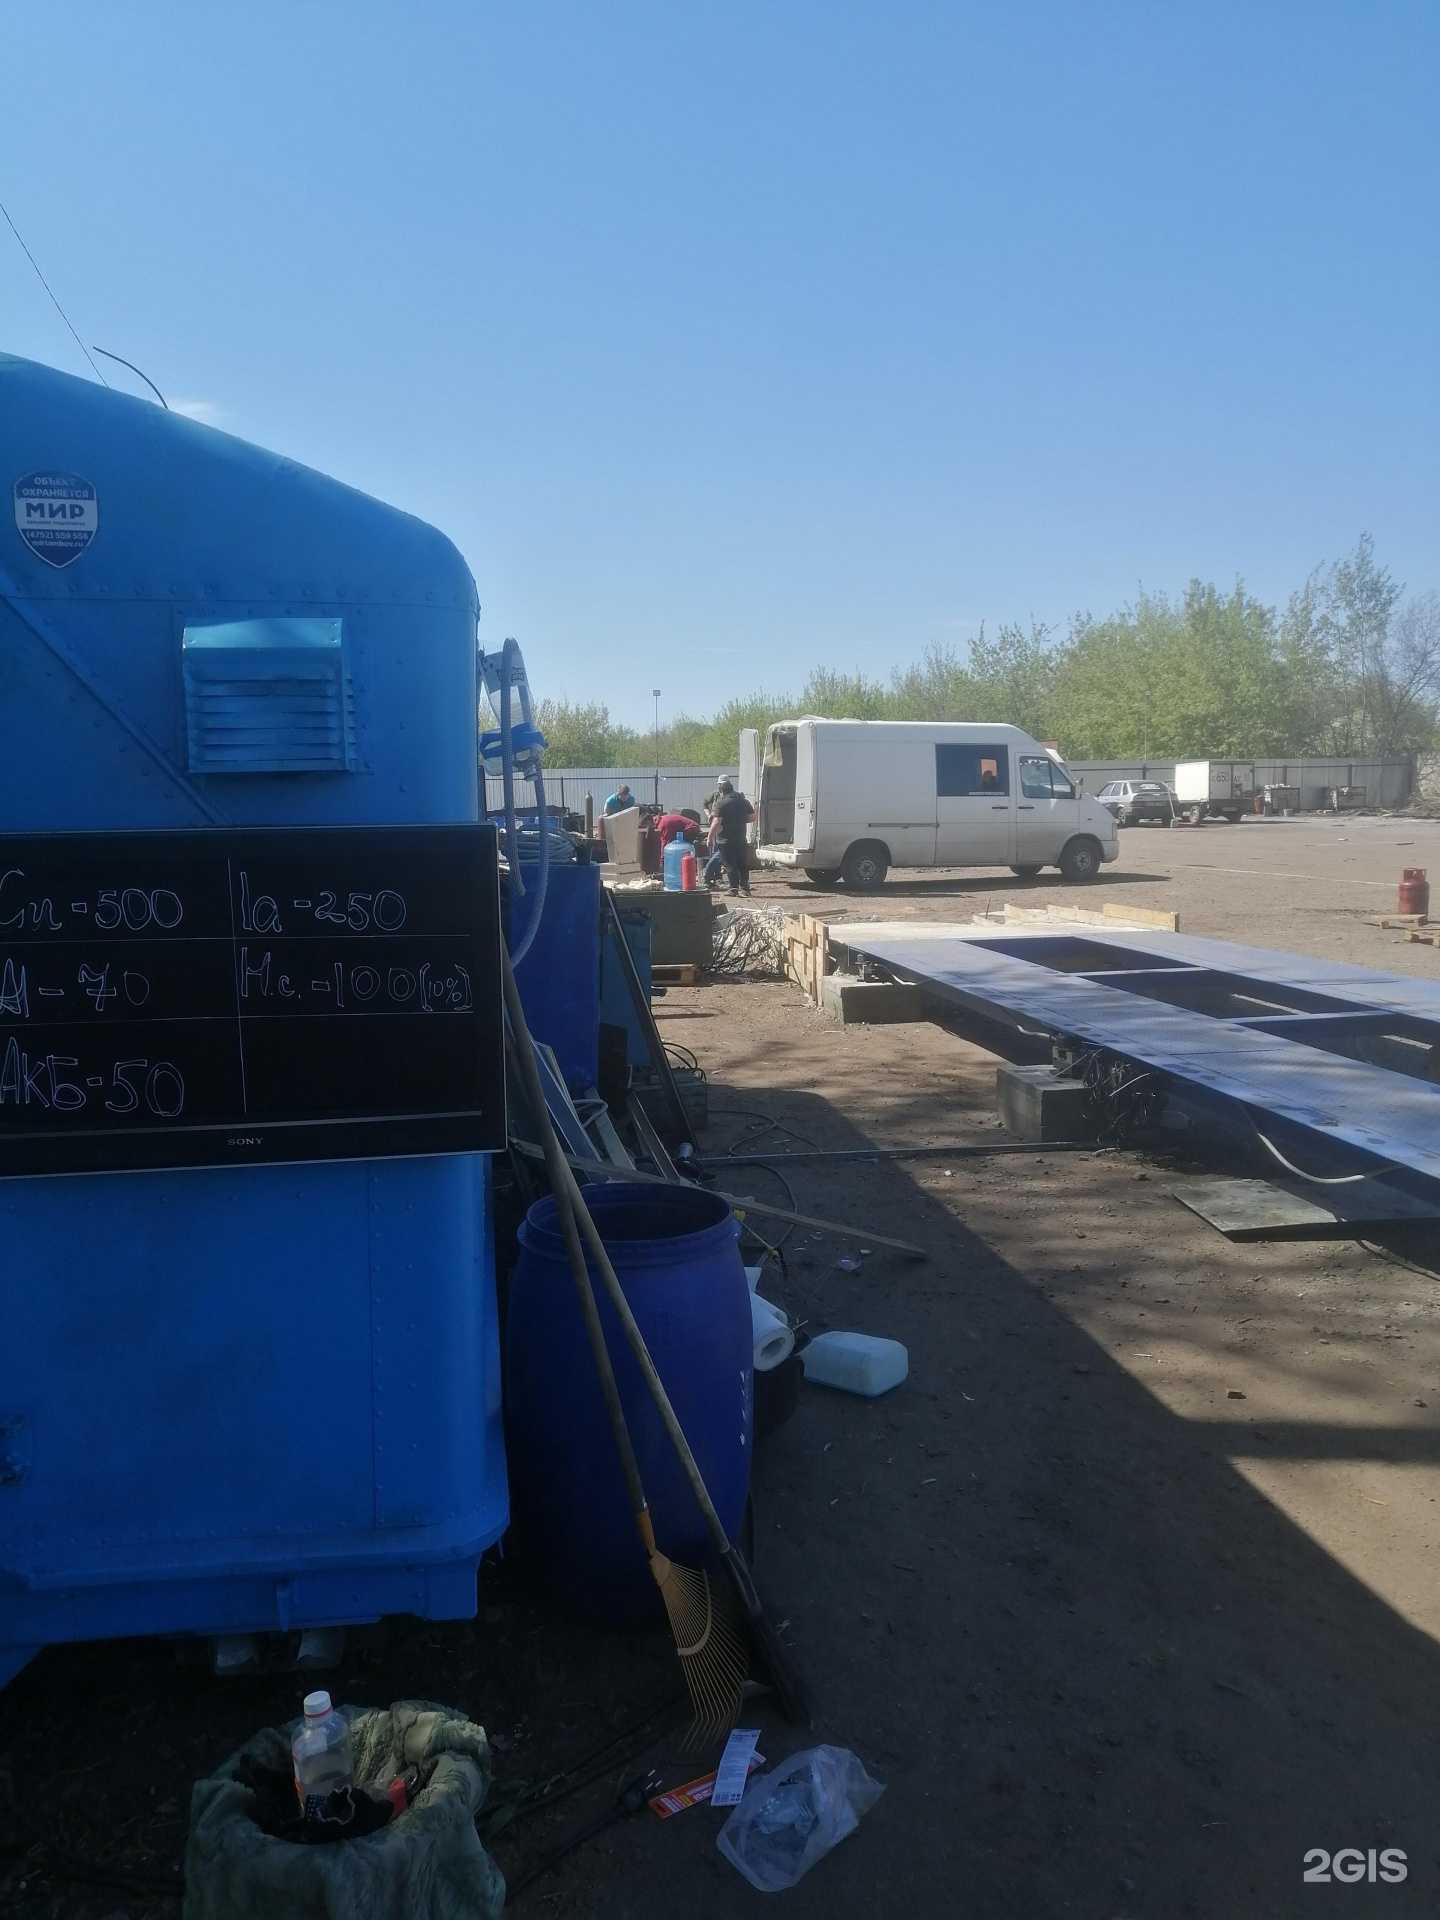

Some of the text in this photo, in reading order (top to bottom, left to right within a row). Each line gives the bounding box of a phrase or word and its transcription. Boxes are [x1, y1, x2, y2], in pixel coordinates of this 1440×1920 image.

[21, 487, 90, 499] ОХРАНЯЕТСЯ
[25, 502, 85, 519] МИР
[226, 1136, 264, 1146] SONY
